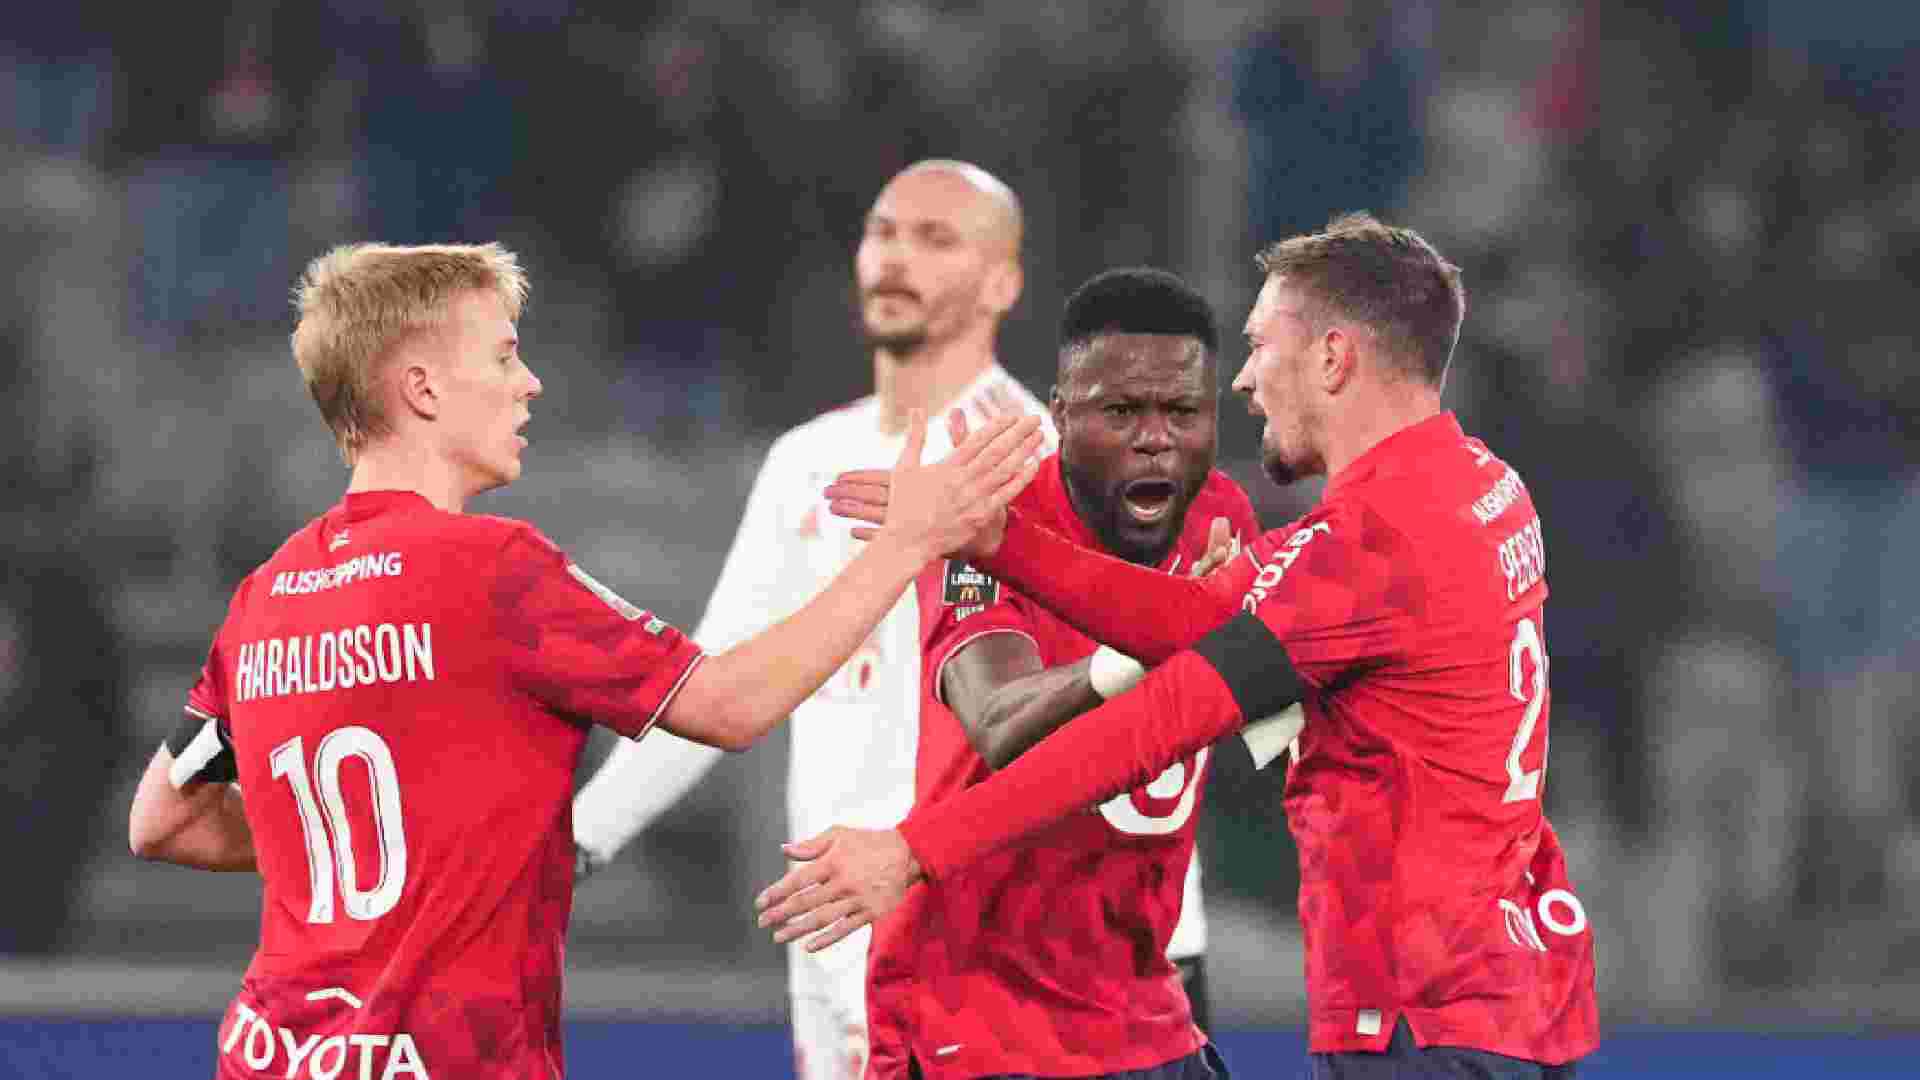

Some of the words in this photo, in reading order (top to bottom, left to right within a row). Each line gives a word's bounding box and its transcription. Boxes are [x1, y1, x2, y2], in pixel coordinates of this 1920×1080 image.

[269, 551, 404, 598] AUSHOPPING
[235, 621, 436, 703] HARALDSSON
[269, 724, 408, 924] 10
[222, 1002, 433, 1080] TOYOTA
